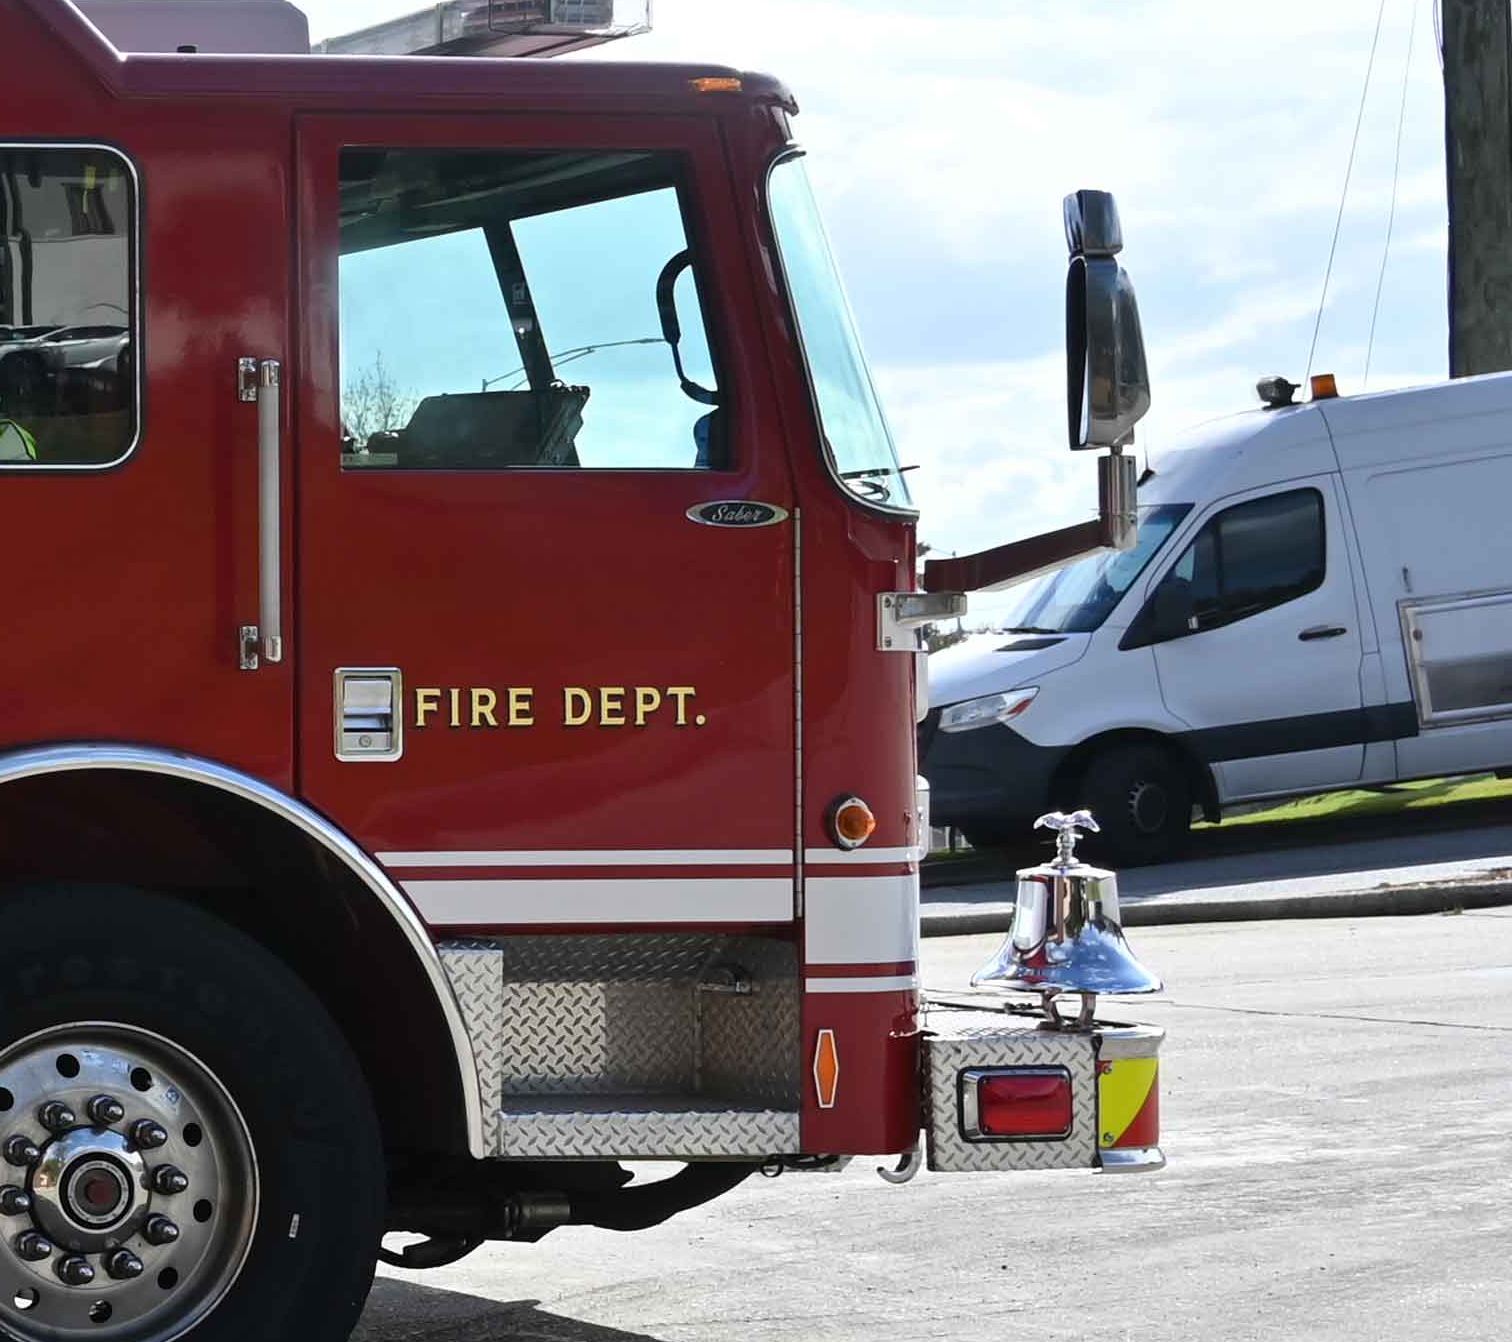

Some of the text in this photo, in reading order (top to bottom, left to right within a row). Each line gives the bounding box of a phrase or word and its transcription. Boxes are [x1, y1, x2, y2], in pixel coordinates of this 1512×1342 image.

[711, 505, 762, 522] Saber
[416, 686, 706, 727] FIRE DEPT.
